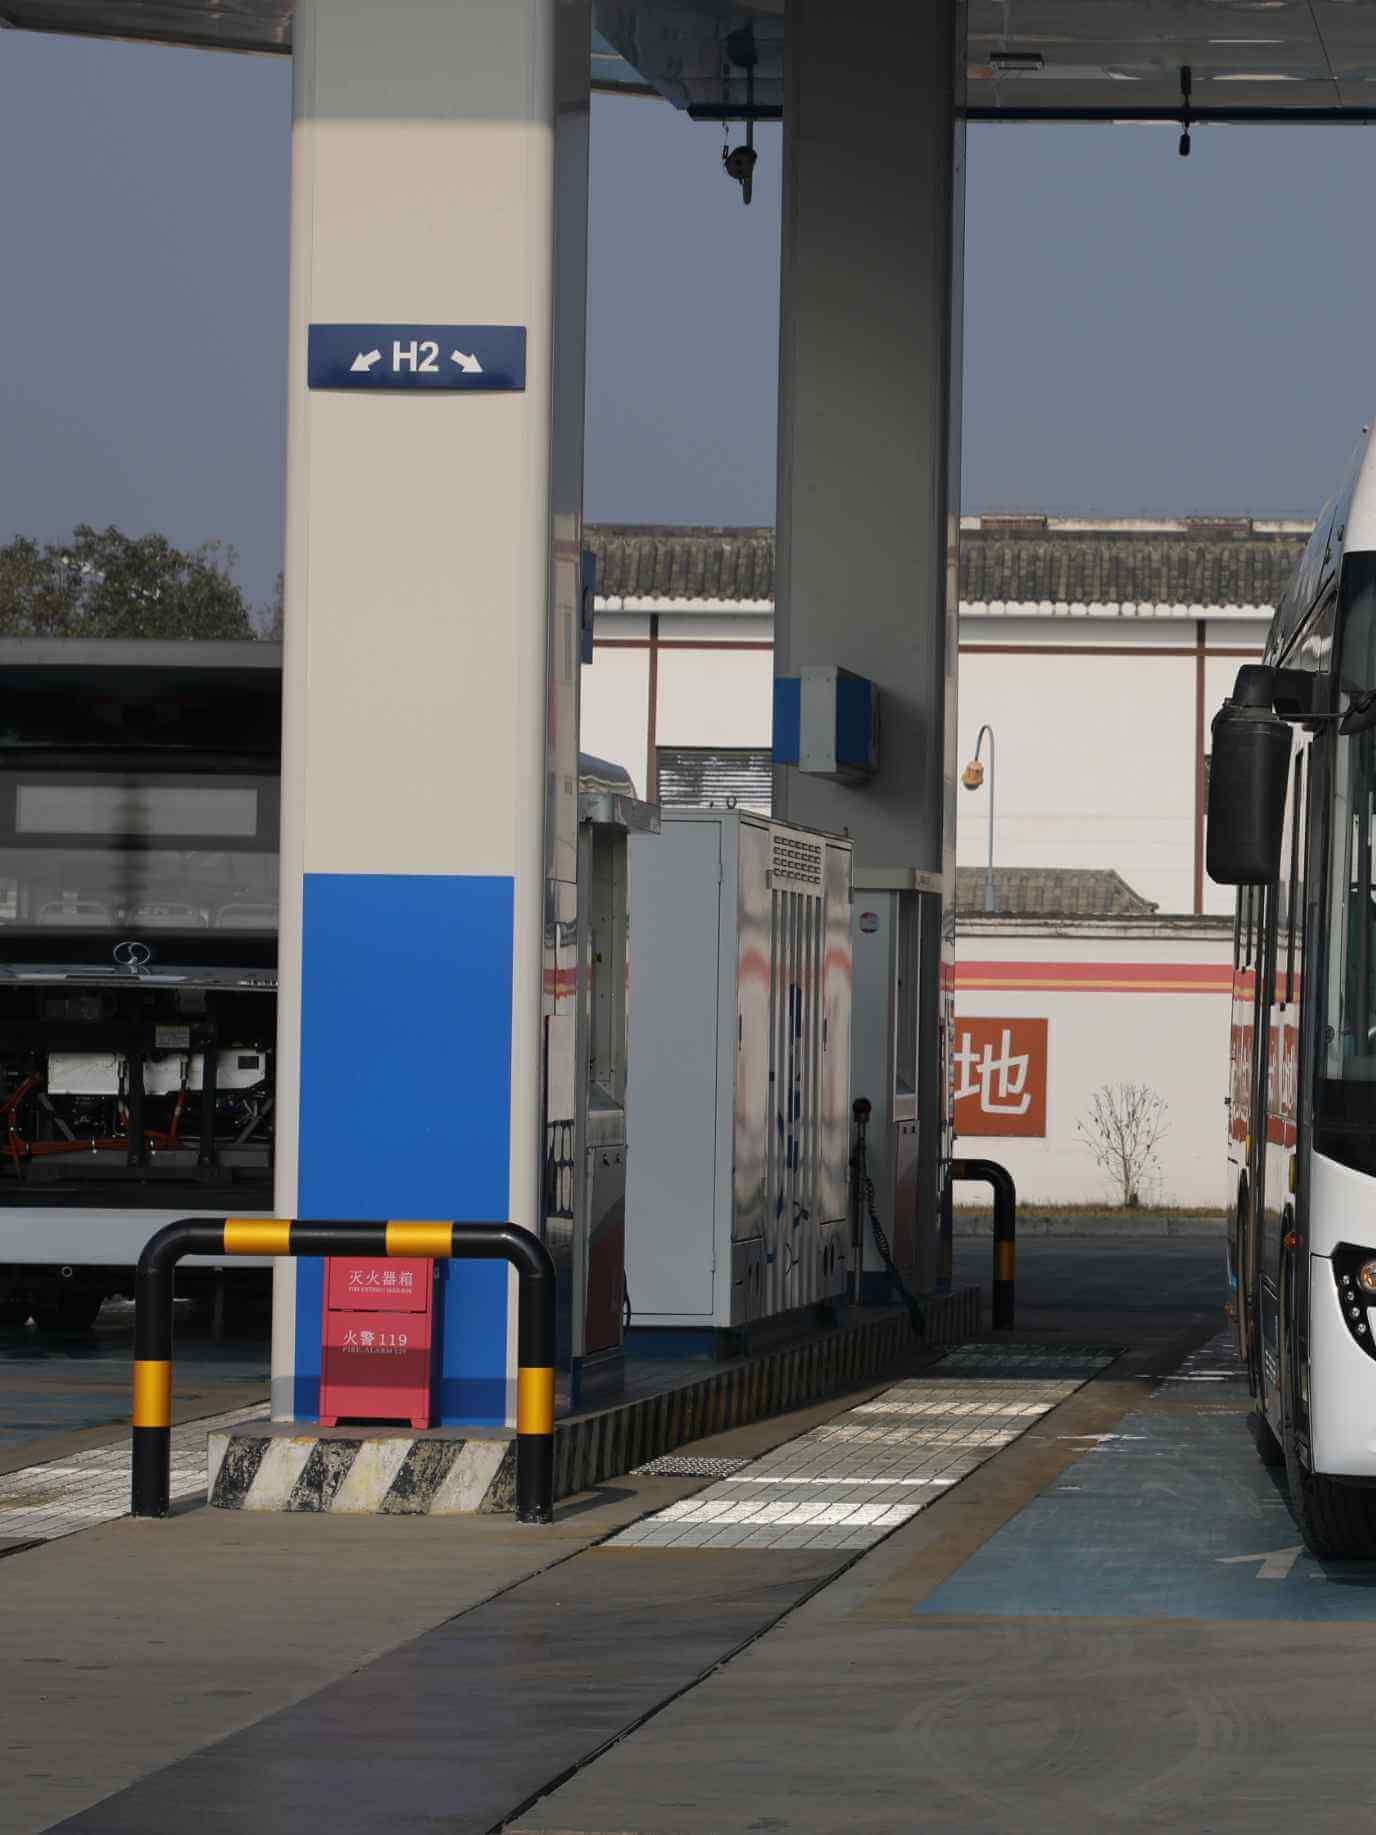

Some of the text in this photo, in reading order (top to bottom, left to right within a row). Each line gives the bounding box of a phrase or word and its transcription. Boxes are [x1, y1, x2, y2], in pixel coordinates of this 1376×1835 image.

[393, 340, 440, 372] H2
[953, 1029, 1032, 1114] 地
[348, 1270, 414, 1286] 灭火器箱
